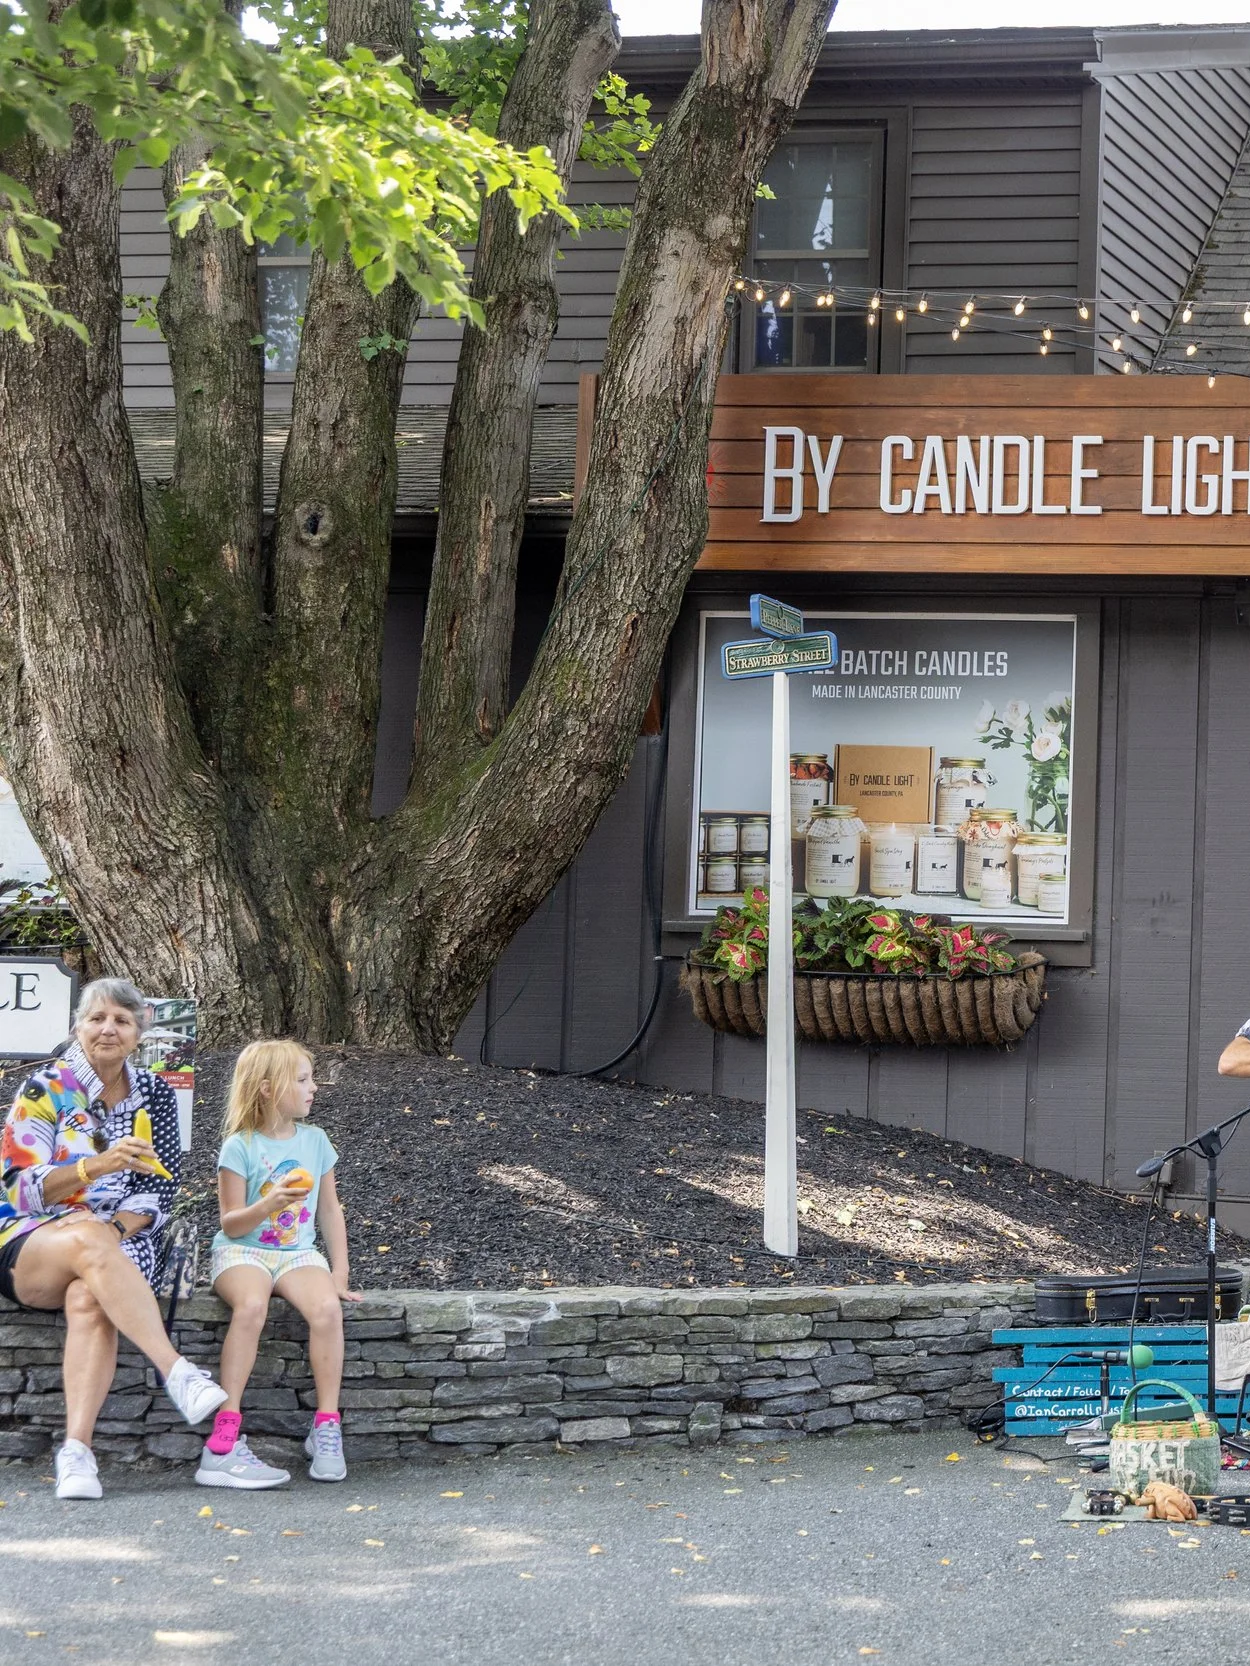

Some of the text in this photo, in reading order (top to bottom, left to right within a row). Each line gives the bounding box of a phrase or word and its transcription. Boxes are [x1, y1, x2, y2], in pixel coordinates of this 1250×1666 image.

[879, 434, 1104, 518] CANDLE
[729, 652, 790, 671] STRAWBERRY
[792, 648, 828, 663] STREET
[840, 649, 1009, 677] BATCH CANDLES
[812, 684, 963, 701] MADE IN LANCASTER COUNTY
[863, 774, 891, 786] CANDLE
[894, 774, 915, 788] LIGHT
[0, 972, 42, 1012] E
[1072, 1385, 1102, 1397] Follo
